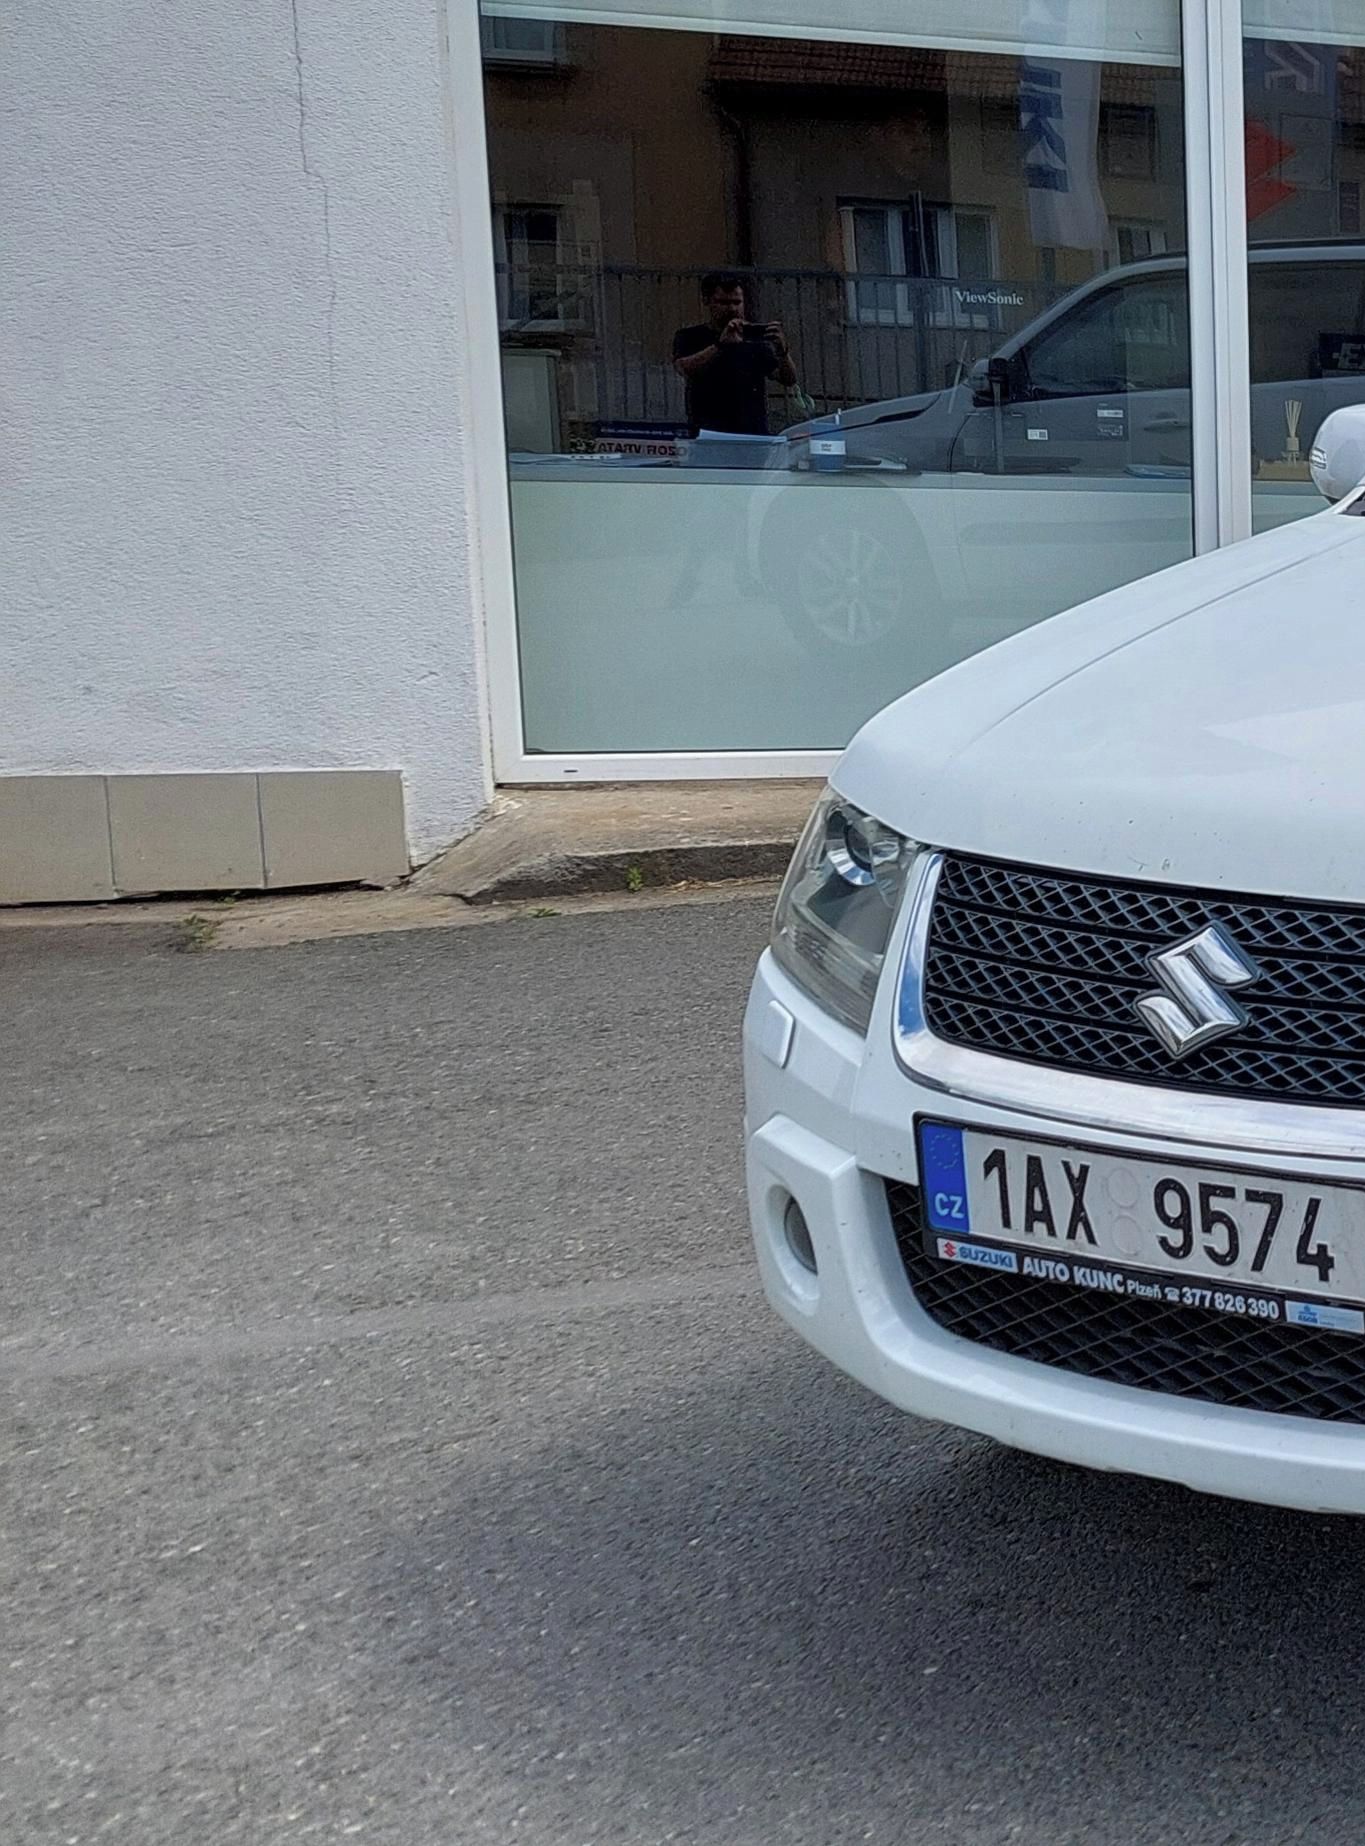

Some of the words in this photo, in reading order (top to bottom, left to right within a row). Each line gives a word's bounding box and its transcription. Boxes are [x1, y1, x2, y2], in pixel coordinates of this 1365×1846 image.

[955, 290, 1024, 306] ViewSonic
[935, 1192, 965, 1219] CZ
[982, 1147, 1100, 1247] 1AX
[1152, 1177, 1336, 1283] 9574
[958, 1245, 1014, 1269] SUZUKI
[1022, 1256, 1070, 1282] AUTO
[1073, 1265, 1125, 1292] KUNC
[1126, 1279, 1162, 1300] Plzeň
[1182, 1286, 1212, 1308] 377
[1214, 1293, 1246, 1314] 826
[1248, 1298, 1280, 1320] 390
